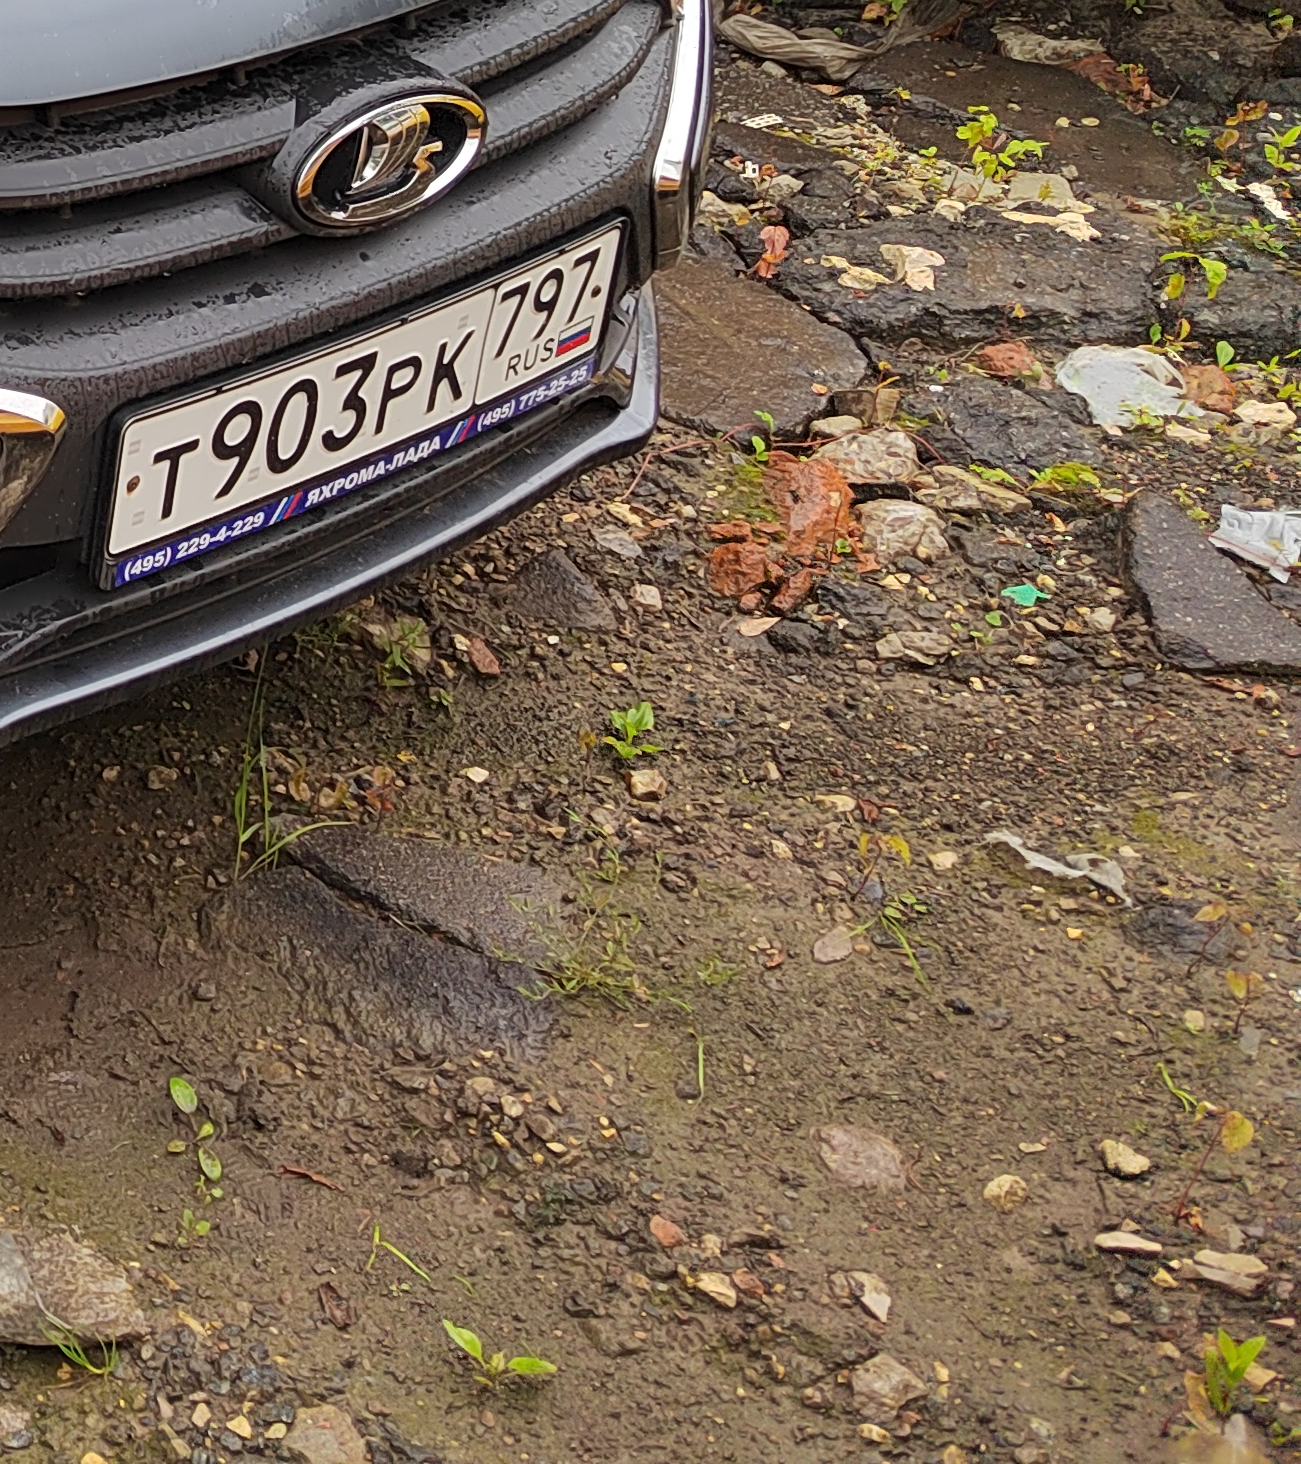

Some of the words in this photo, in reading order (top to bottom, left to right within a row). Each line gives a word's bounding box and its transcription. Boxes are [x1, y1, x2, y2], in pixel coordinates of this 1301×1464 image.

[152, 329, 476, 521] Т903РК
[495, 246, 602, 360] 797
[504, 337, 556, 382] RUS
[124, 546, 172, 582] (495)
[176, 511, 266, 559] 229-4-229
[304, 434, 441, 508] ЯХРОМА-ЛАДА
[477, 398, 515, 432] (495)
[518, 365, 588, 410] 775-25-25
